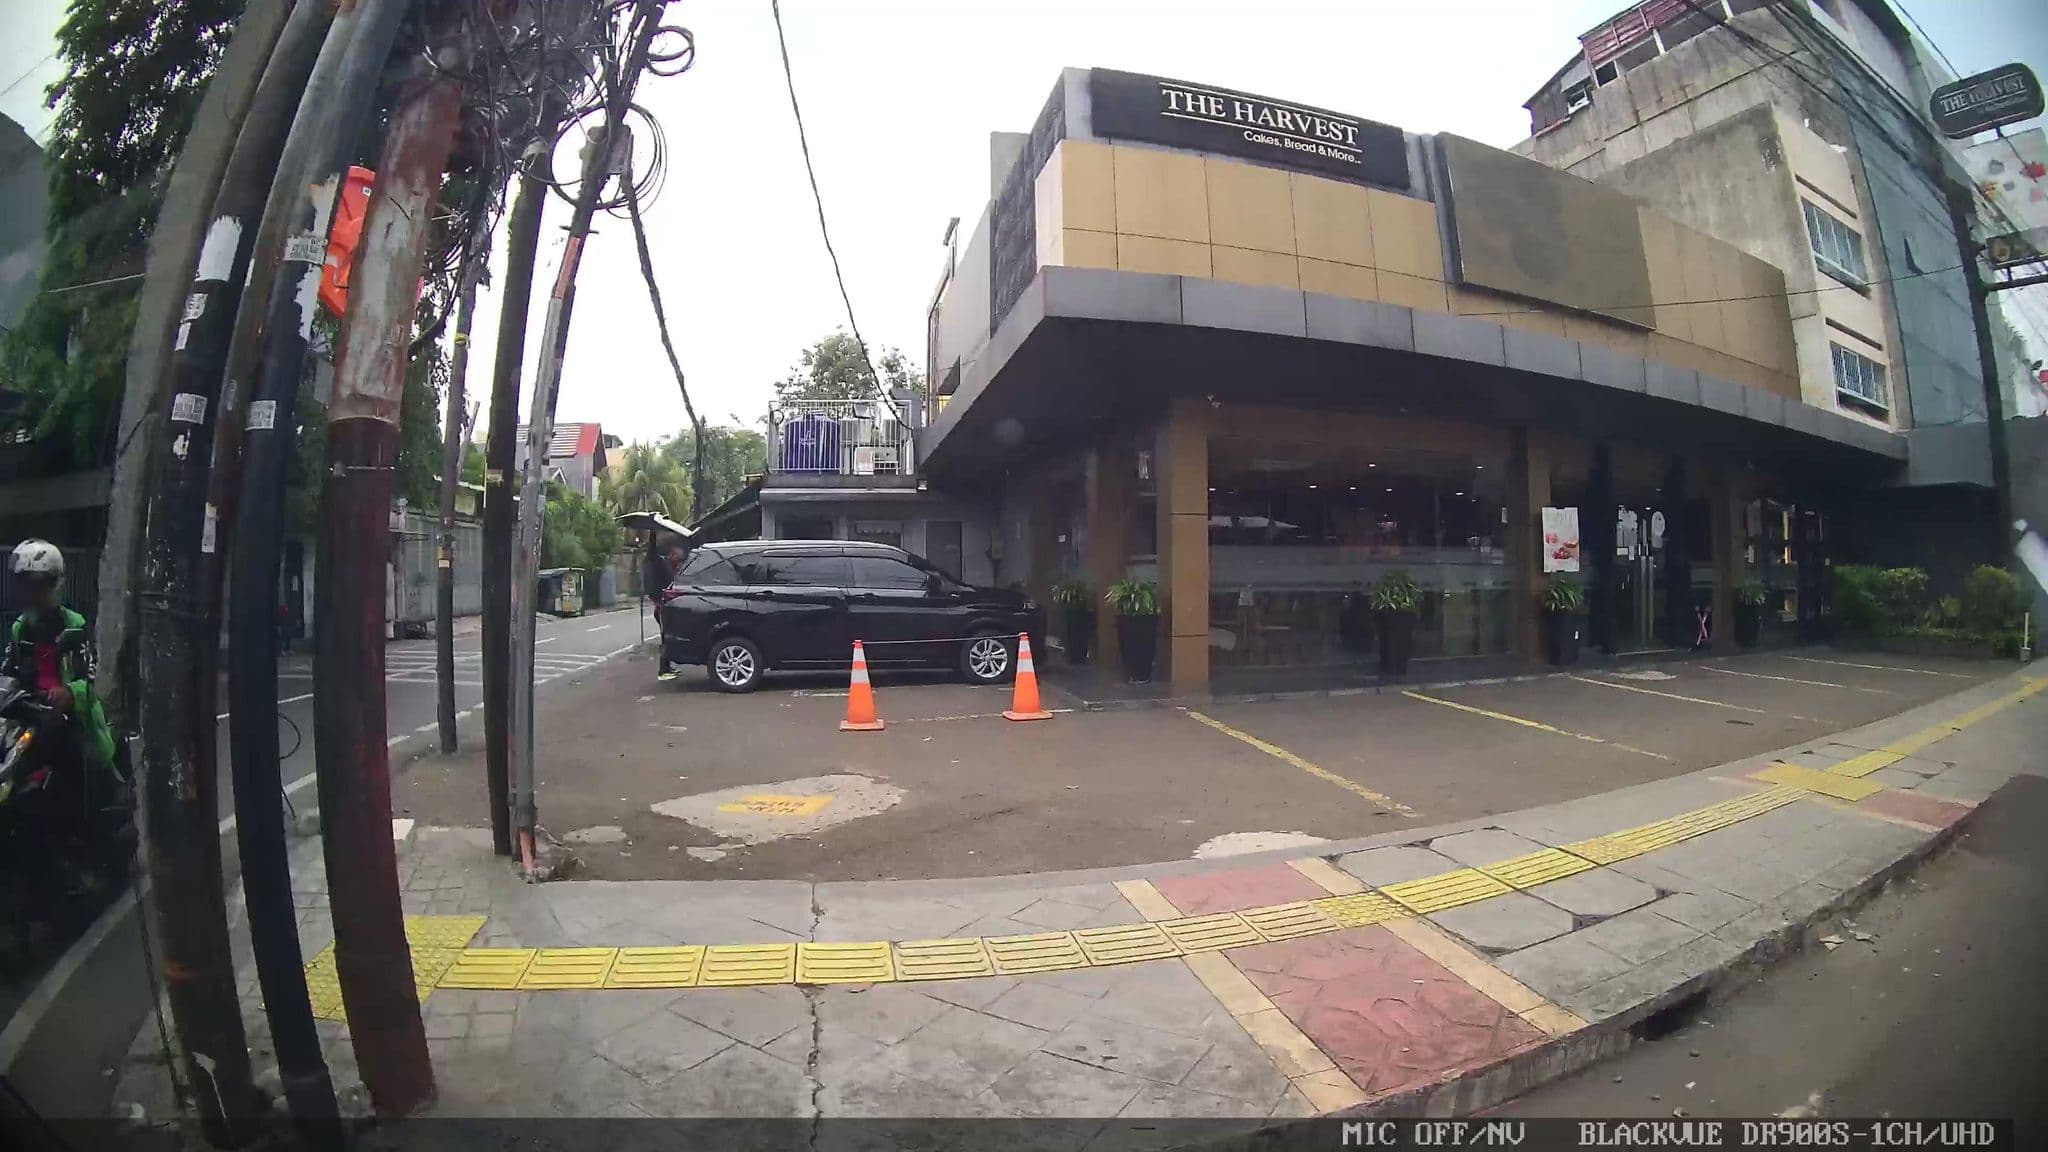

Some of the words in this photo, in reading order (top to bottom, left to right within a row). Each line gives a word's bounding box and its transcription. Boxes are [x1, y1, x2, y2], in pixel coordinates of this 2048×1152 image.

[1162, 89, 1226, 118] THE
[1234, 101, 1359, 145] HARVEST
[1244, 130, 1283, 148] Cakes,
[1284, 138, 1317, 153] Bread
[1318, 144, 1327, 155] &
